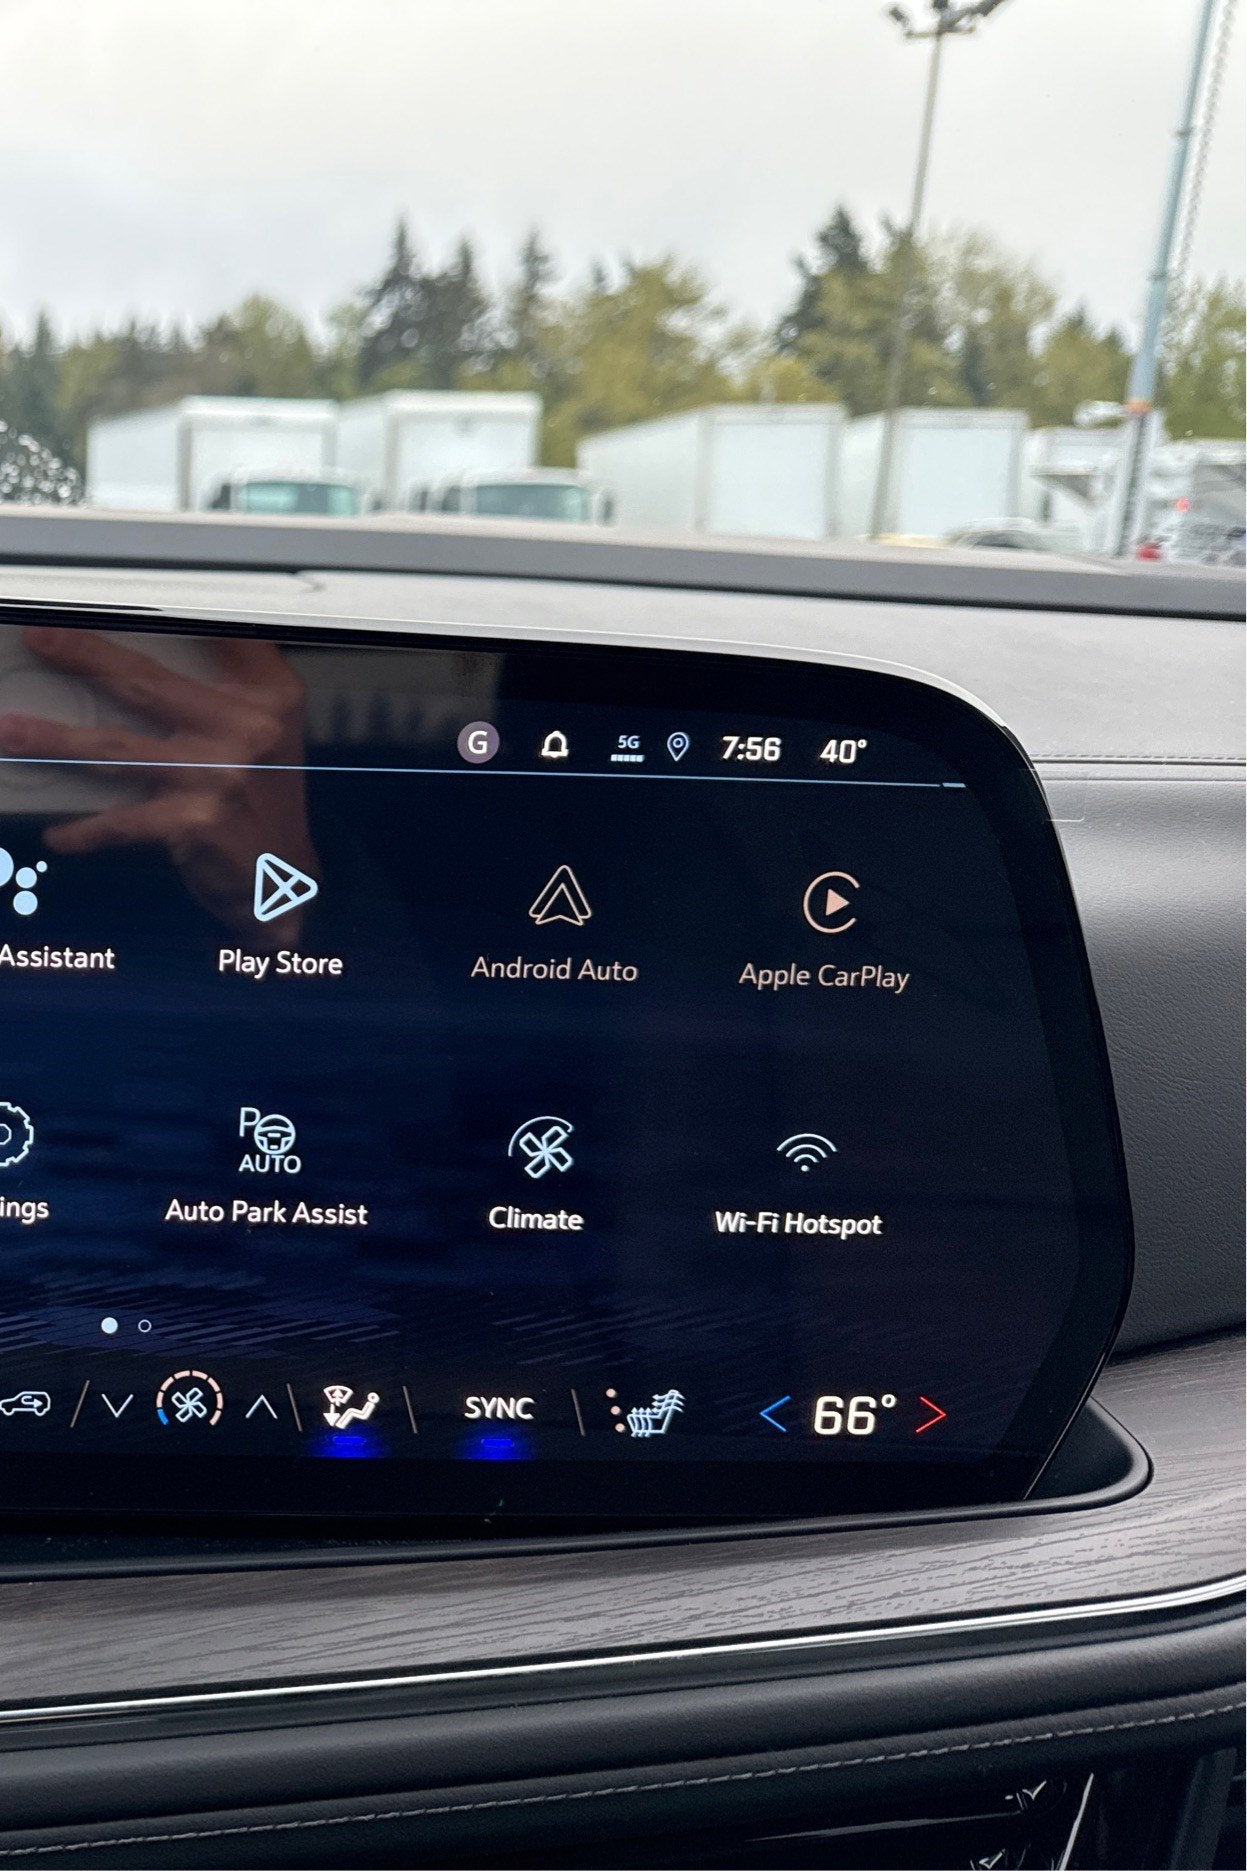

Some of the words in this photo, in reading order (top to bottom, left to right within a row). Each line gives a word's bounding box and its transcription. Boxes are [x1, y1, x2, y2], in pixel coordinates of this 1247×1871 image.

[467, 730, 488, 755] G
[617, 734, 640, 749] 5G
[722, 735, 782, 762] 7:56
[819, 738, 868, 764] 40°
[218, 948, 270, 980] Play
[275, 950, 343, 975] Store
[470, 955, 572, 980] Android
[577, 958, 638, 982] Auto
[738, 962, 811, 991] Apple
[818, 964, 910, 994] CarPlay
[238, 1154, 302, 1174] AUTO
[164, 1198, 225, 1222] Auto
[232, 1199, 287, 1223] Park
[291, 1201, 369, 1225] Assist
[488, 1205, 584, 1231] Climate
[715, 1210, 780, 1233] Wi-Fi
[784, 1212, 883, 1241] Hotspot
[464, 1396, 535, 1420] SYNC
[813, 1393, 897, 1435] 66°
